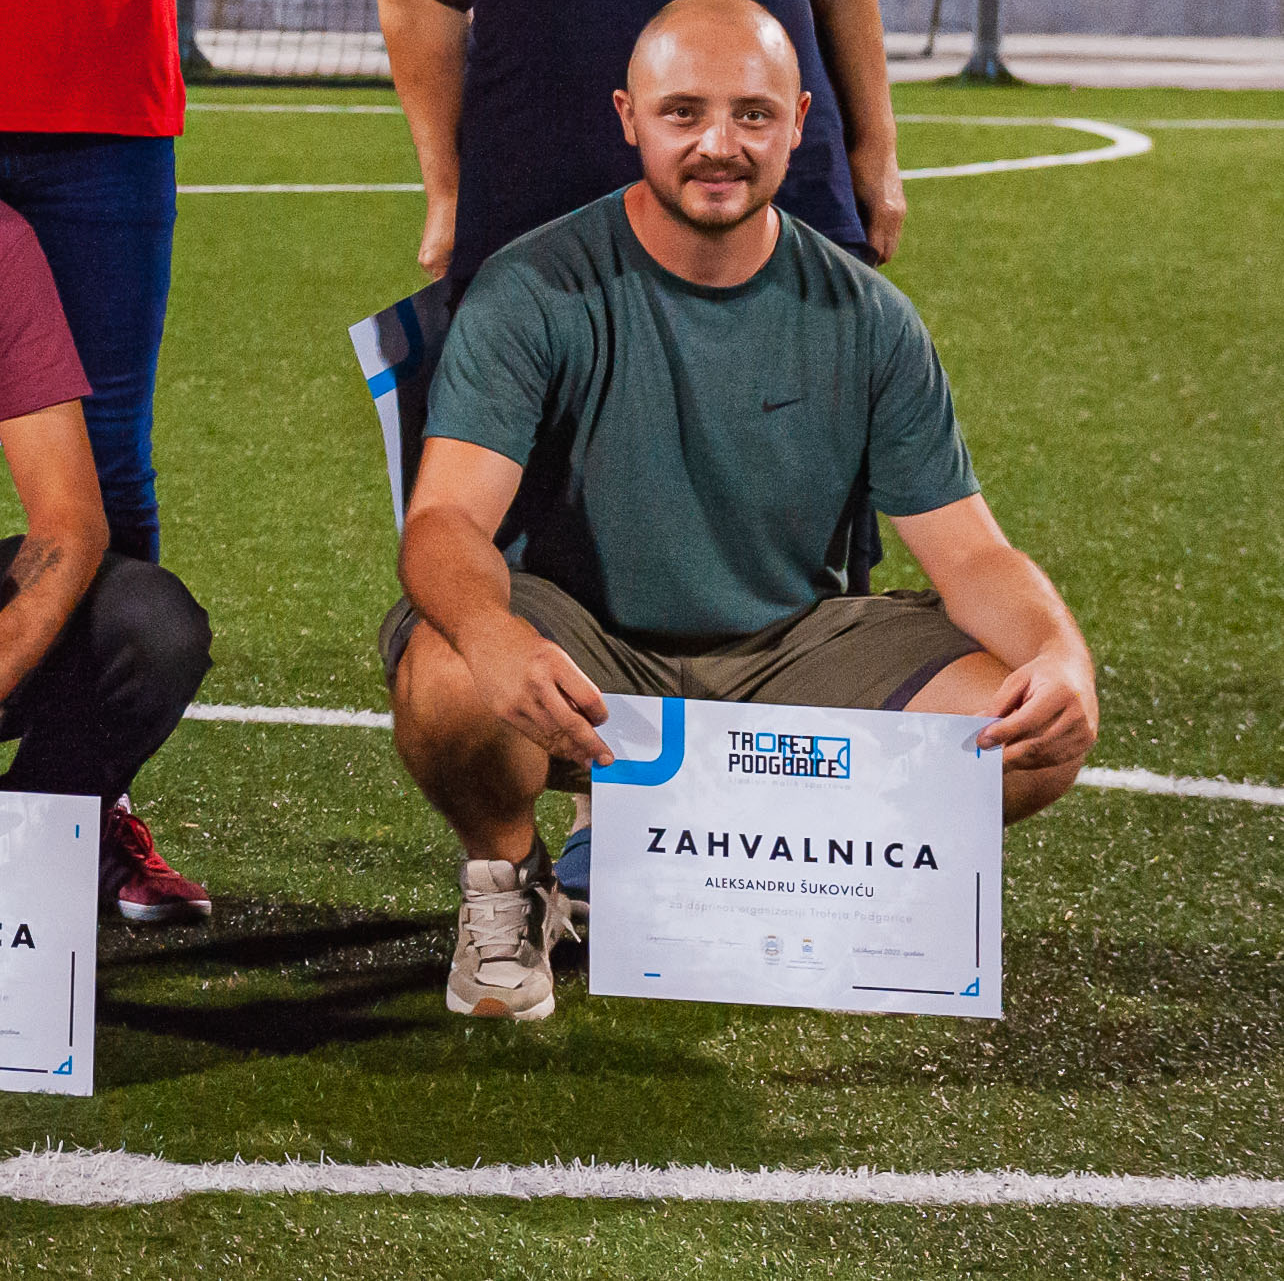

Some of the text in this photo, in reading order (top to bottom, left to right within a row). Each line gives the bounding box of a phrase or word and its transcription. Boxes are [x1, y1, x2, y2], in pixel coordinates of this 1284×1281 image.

[727, 730, 815, 755] TROFEJ
[728, 753, 839, 778] PODGORICE
[646, 827, 938, 870] ZAHVALNICA
[705, 877, 874, 898] ALEKSANDRU ŠUKOVIĆU
